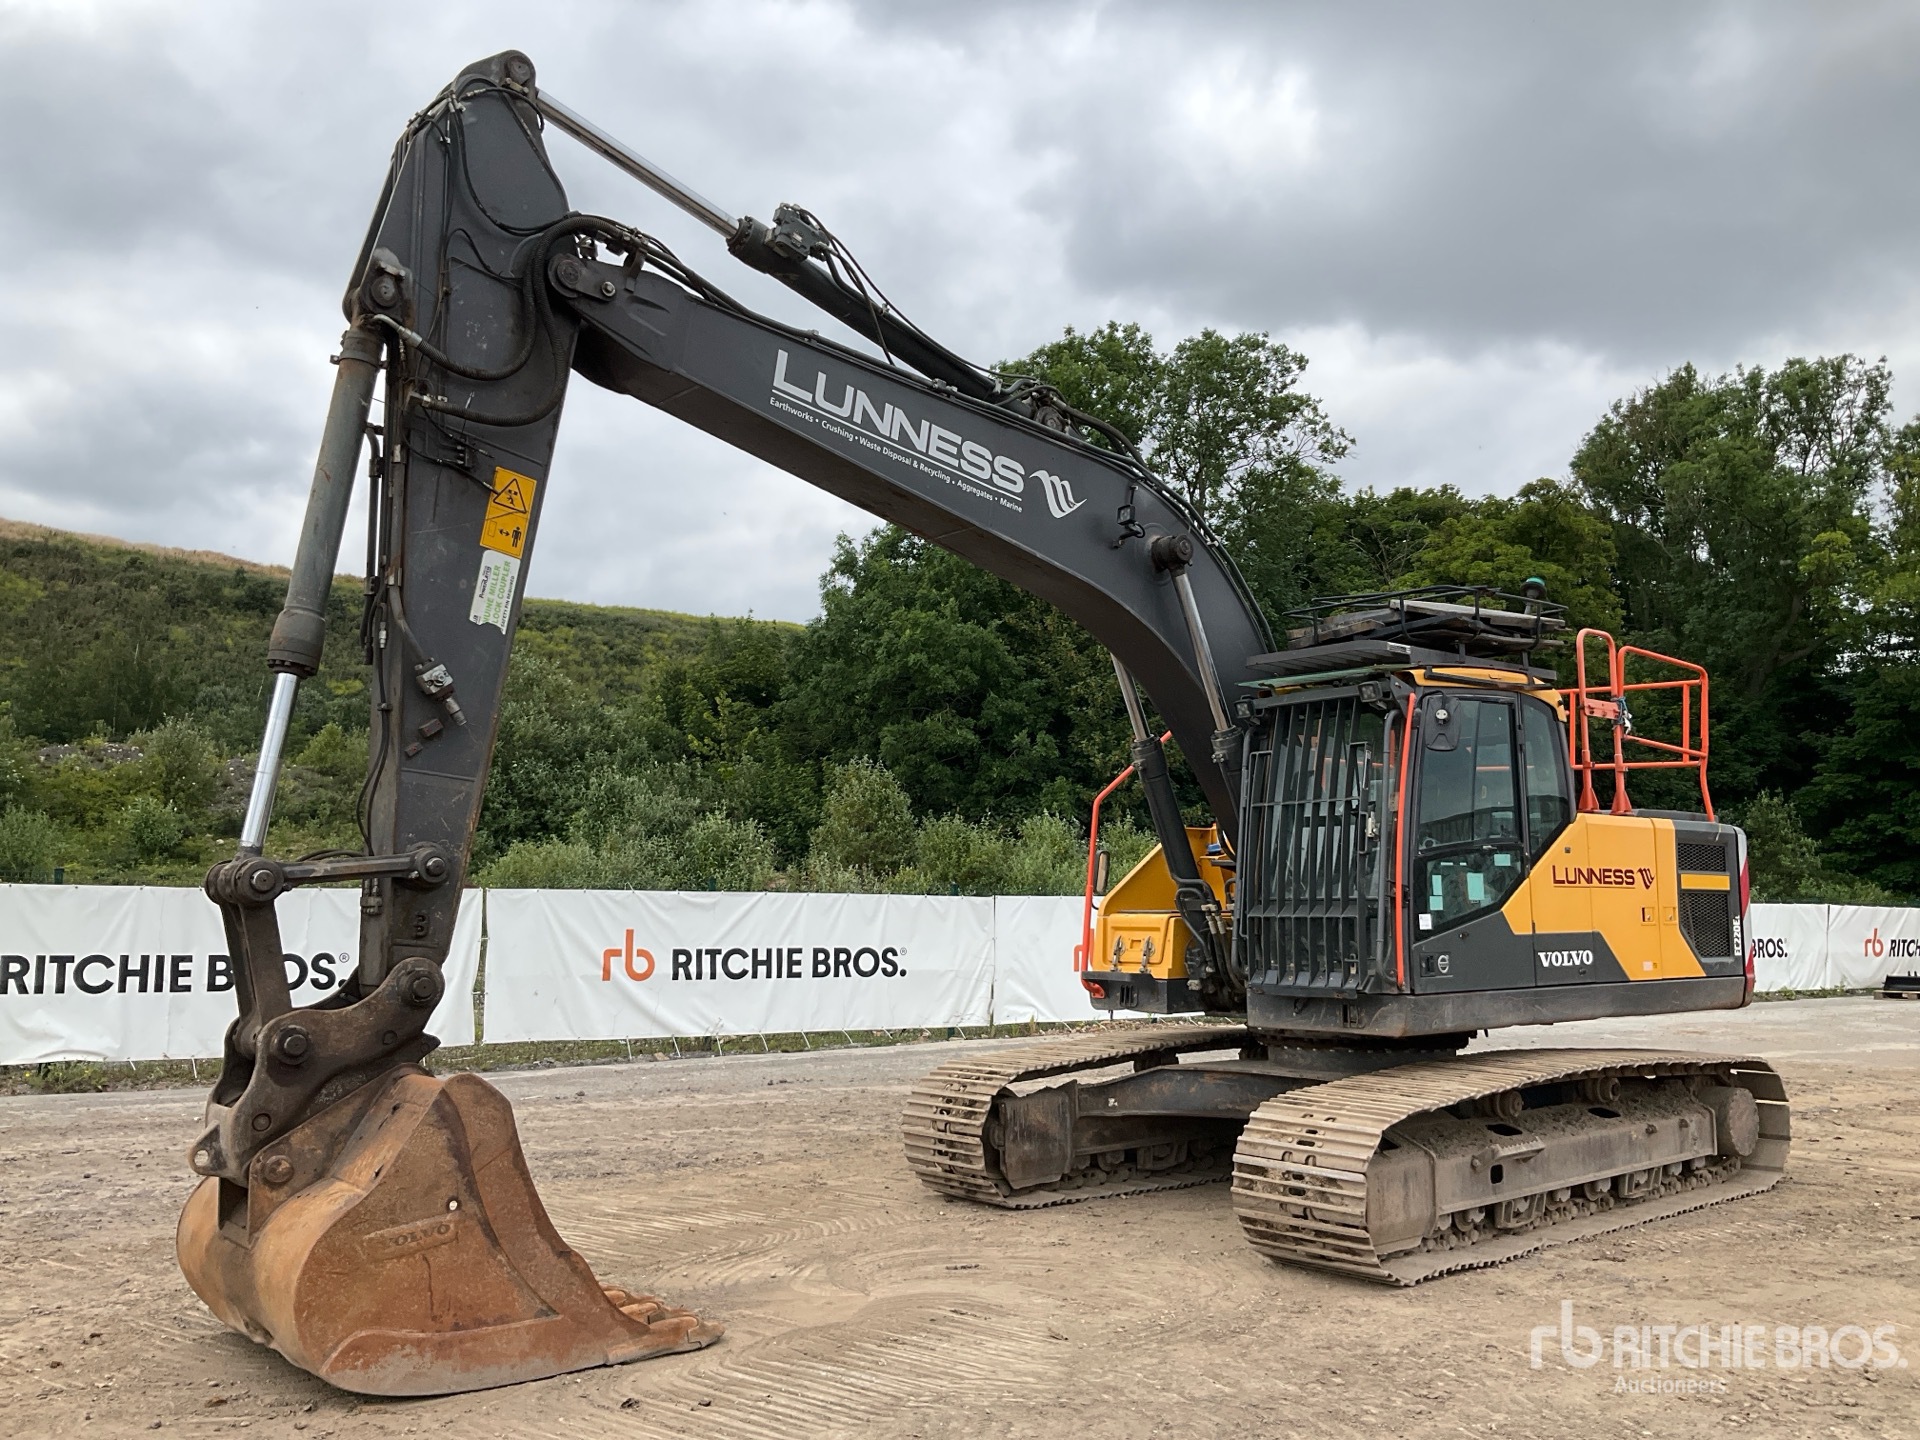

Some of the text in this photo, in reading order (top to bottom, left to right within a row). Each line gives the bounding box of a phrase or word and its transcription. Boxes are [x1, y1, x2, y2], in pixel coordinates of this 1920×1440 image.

[773, 349, 1026, 493] LUNNESS
[769, 396, 1023, 513] Earthworks Crushing Waste Disposal & Recycling Aggregates Marine
[488, 564, 501, 596] MILLER
[492, 560, 511, 624] LOCK COUPLER
[1552, 865, 1635, 885] LUNNESS
[0, 952, 347, 995] RITCHIE BOS.
[671, 947, 803, 981] RITCHIE
[1538, 950, 1593, 968] VOLVO
